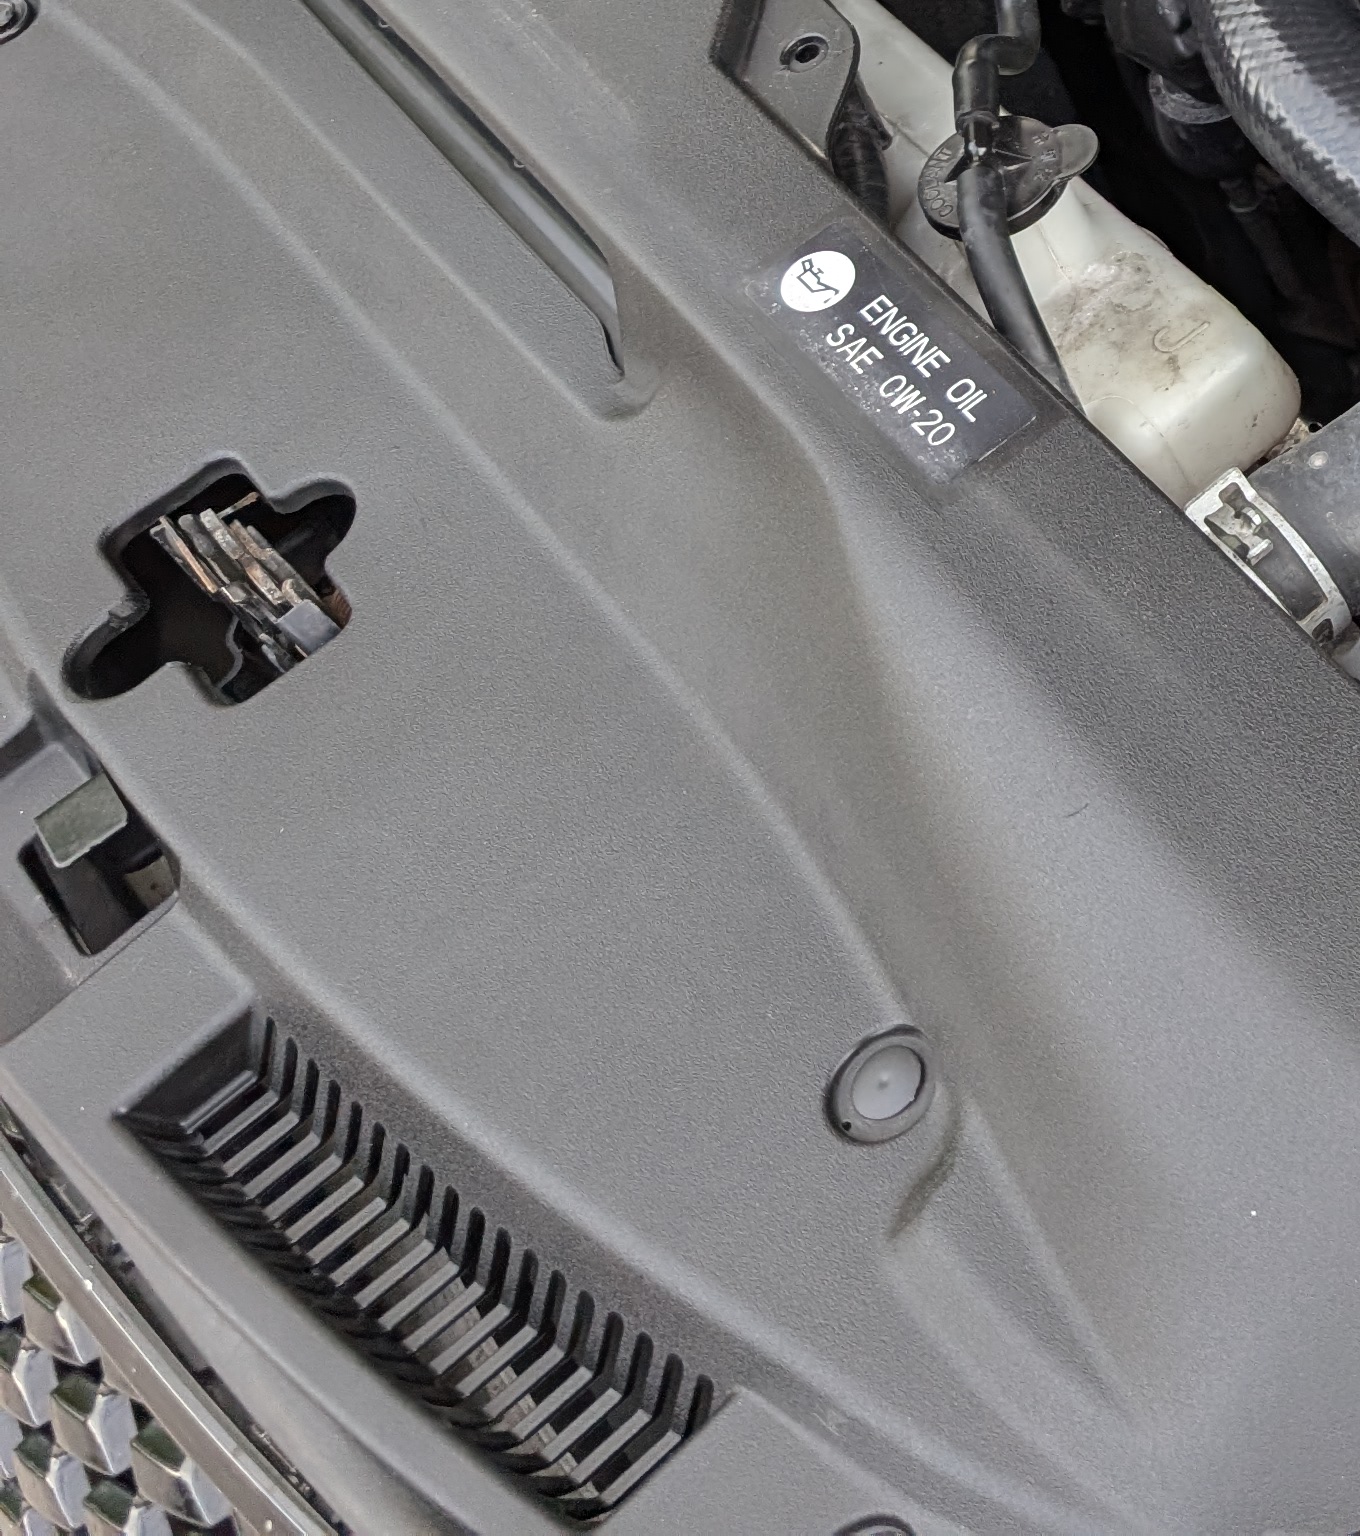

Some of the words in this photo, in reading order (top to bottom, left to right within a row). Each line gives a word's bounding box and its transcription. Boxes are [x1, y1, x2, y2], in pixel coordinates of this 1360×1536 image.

[923, 147, 954, 218] COOLANT
[826, 323, 884, 375] SAE
[879, 374, 956, 447] 0W-20
[860, 294, 951, 378] ENGINE
[946, 378, 988, 423] OIL
